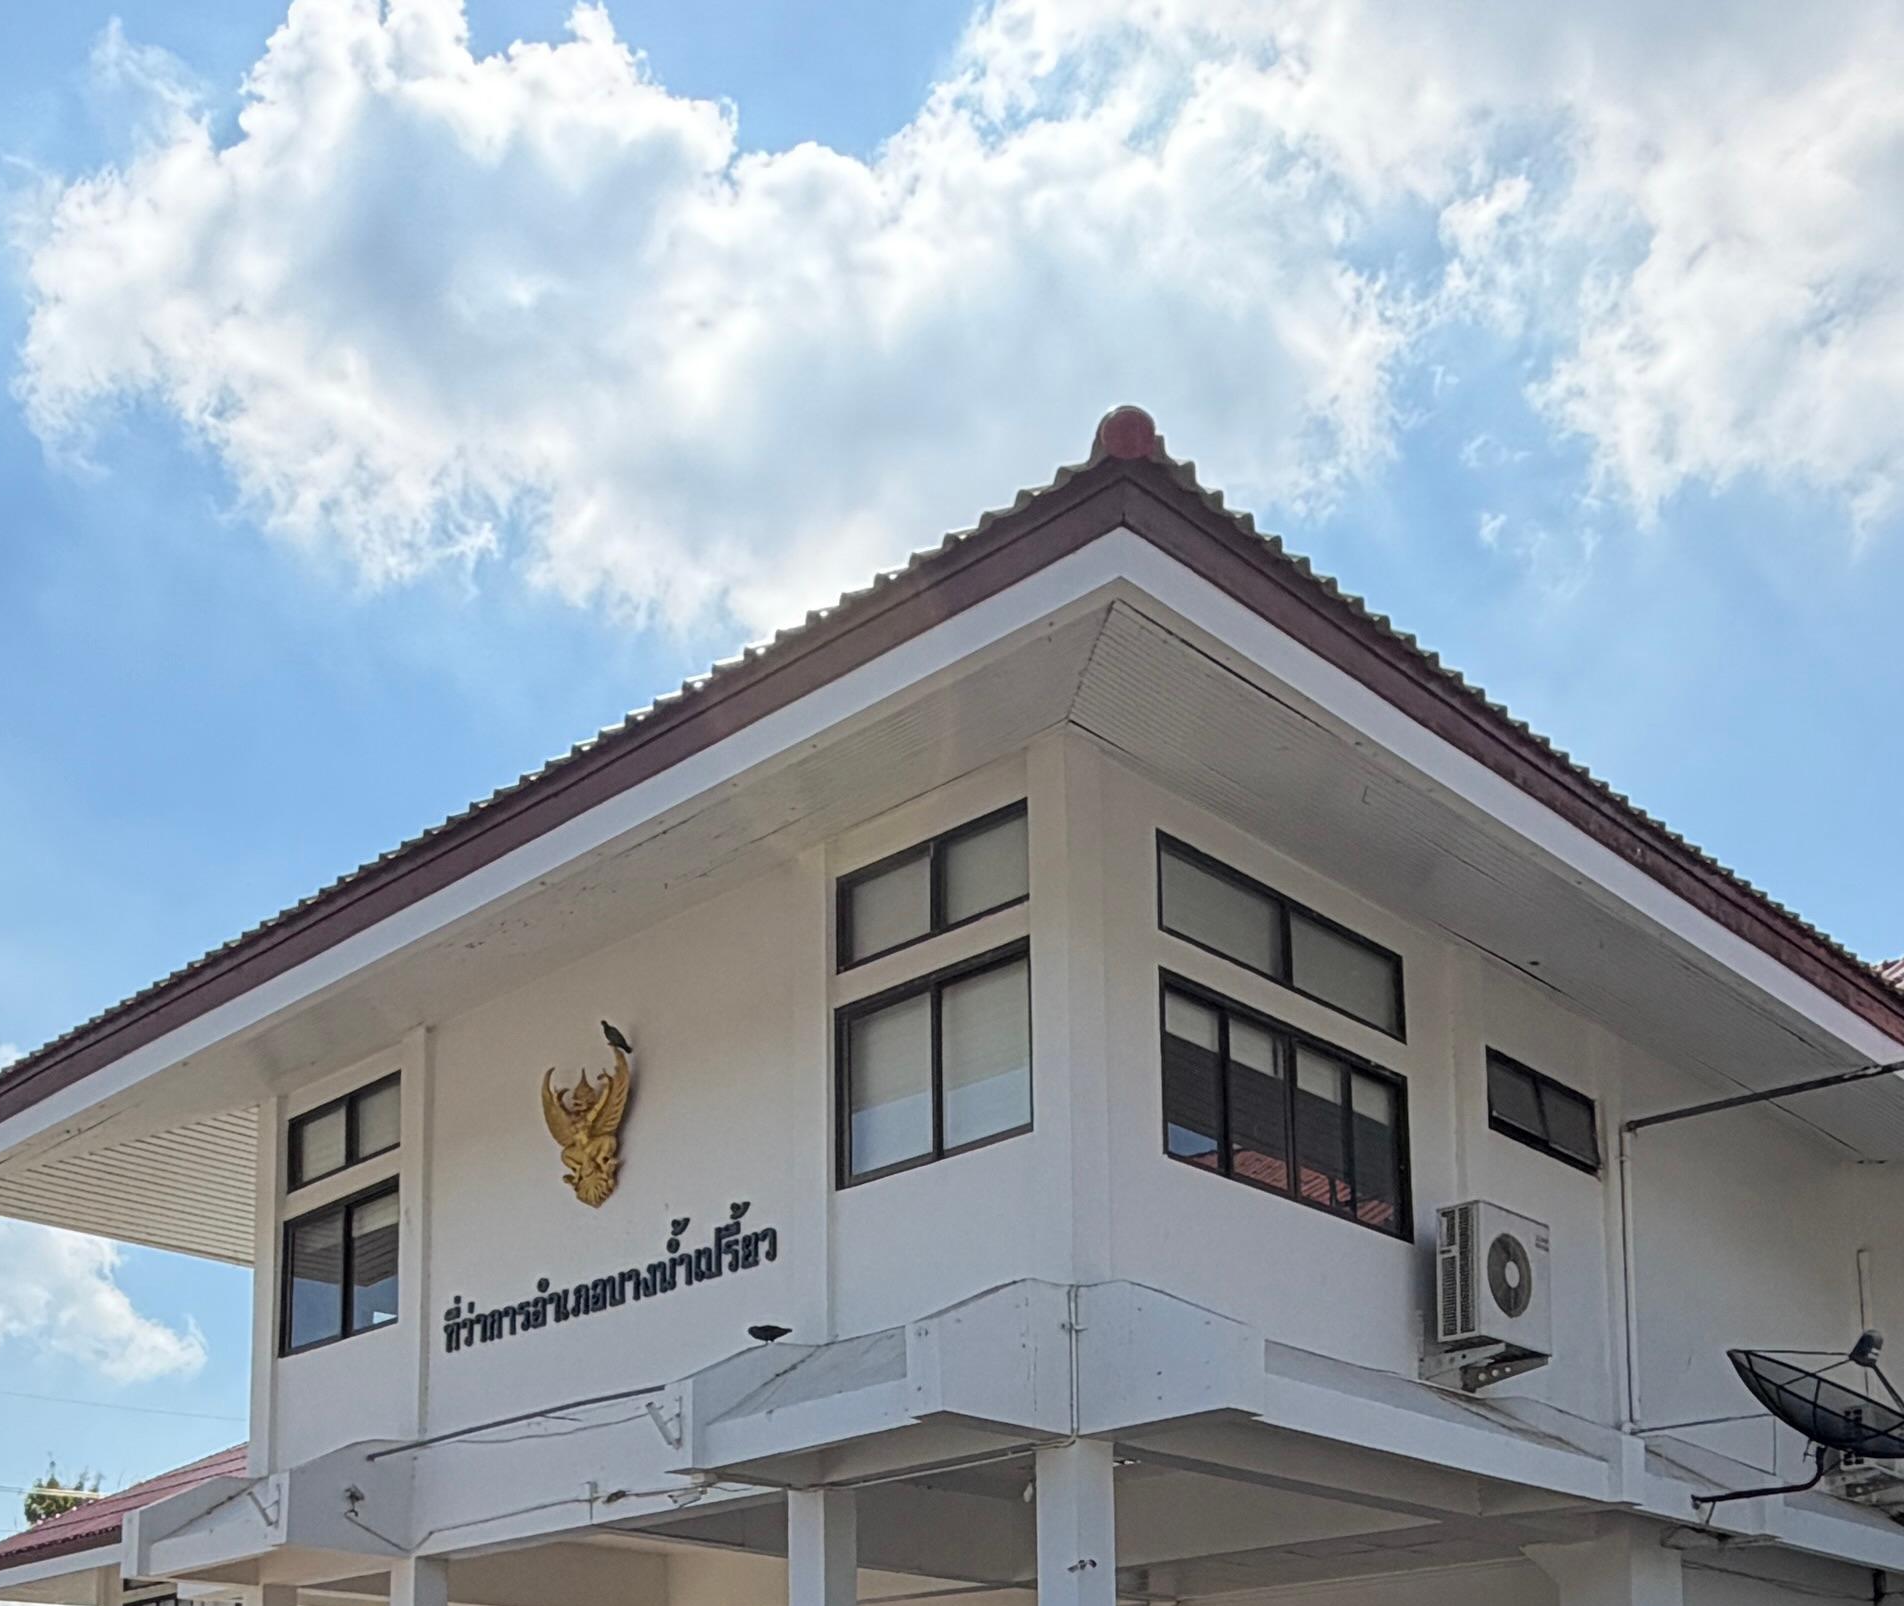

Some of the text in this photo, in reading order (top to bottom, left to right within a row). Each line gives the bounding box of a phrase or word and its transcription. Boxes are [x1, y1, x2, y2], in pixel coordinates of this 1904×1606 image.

[443, 1201, 778, 1352] ที่ว่าการอำเภอบางน้ำเปรี้ยว
